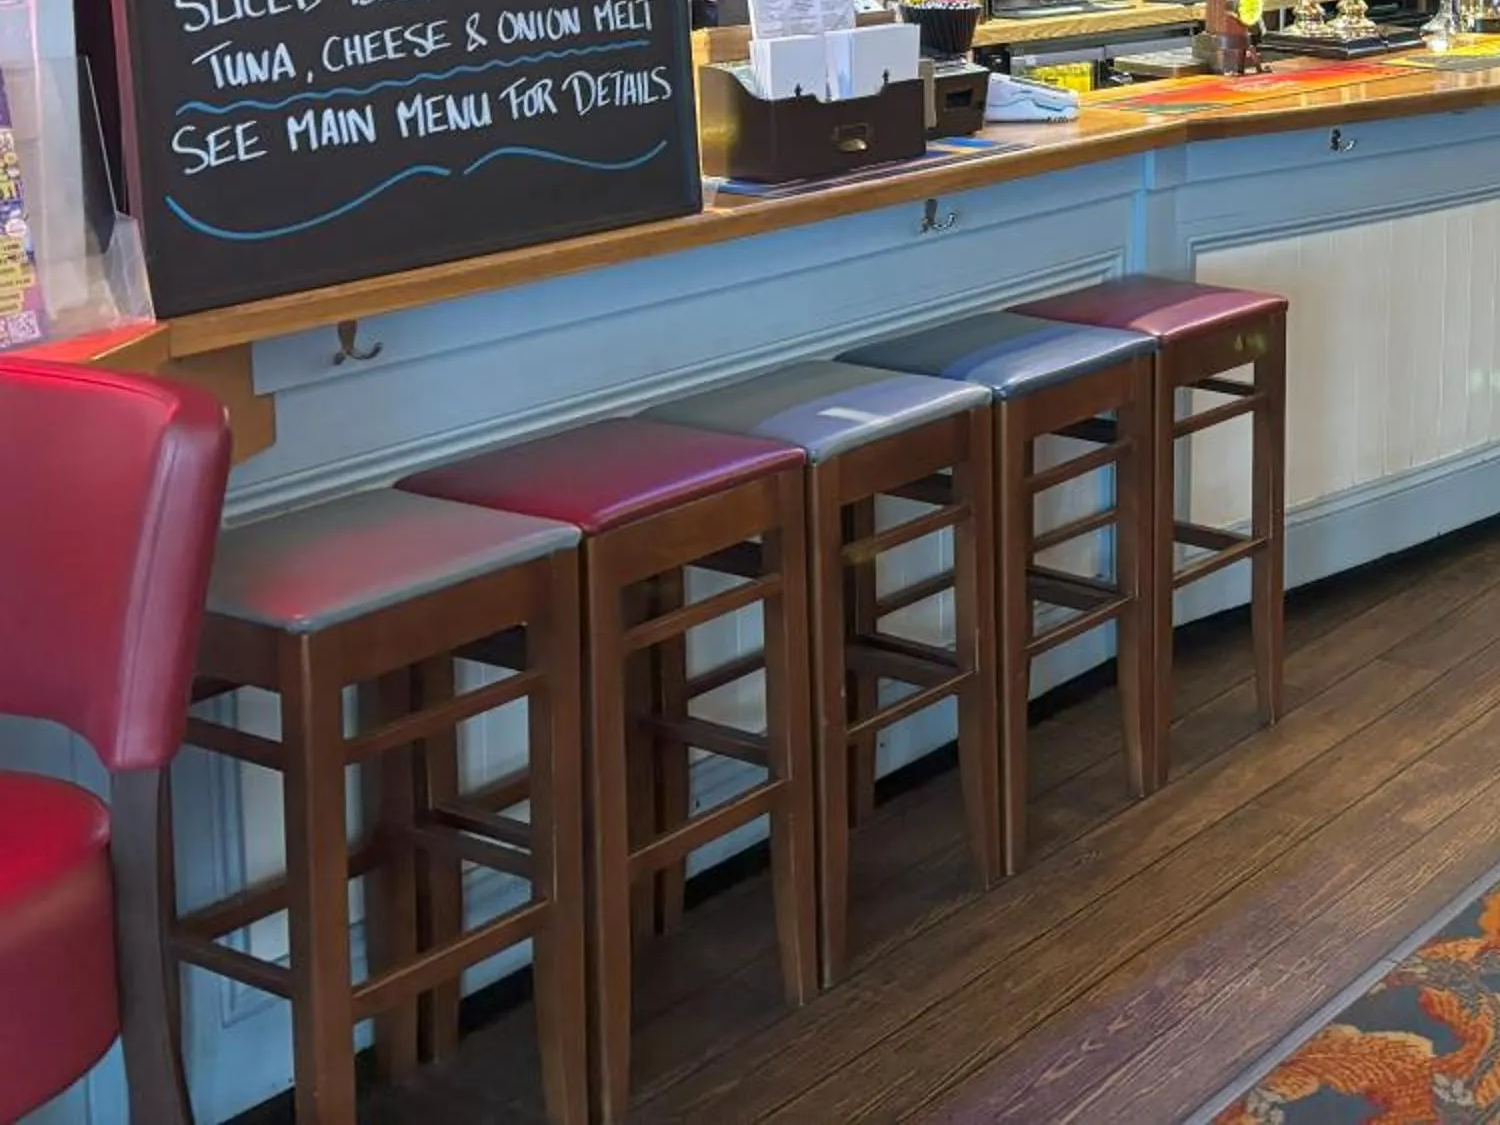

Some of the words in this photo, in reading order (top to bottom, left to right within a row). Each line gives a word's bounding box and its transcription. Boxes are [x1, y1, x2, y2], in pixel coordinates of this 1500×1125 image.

[321, 19, 453, 73] CHEESE
[465, 12, 488, 52] &
[497, 5, 581, 45] ONION
[172, 119, 269, 175] SEE
[286, 102, 378, 153] MAIN
[396, 90, 494, 140] MENU
[498, 79, 558, 122] FOR
[561, 65, 674, 116] DETAILS
